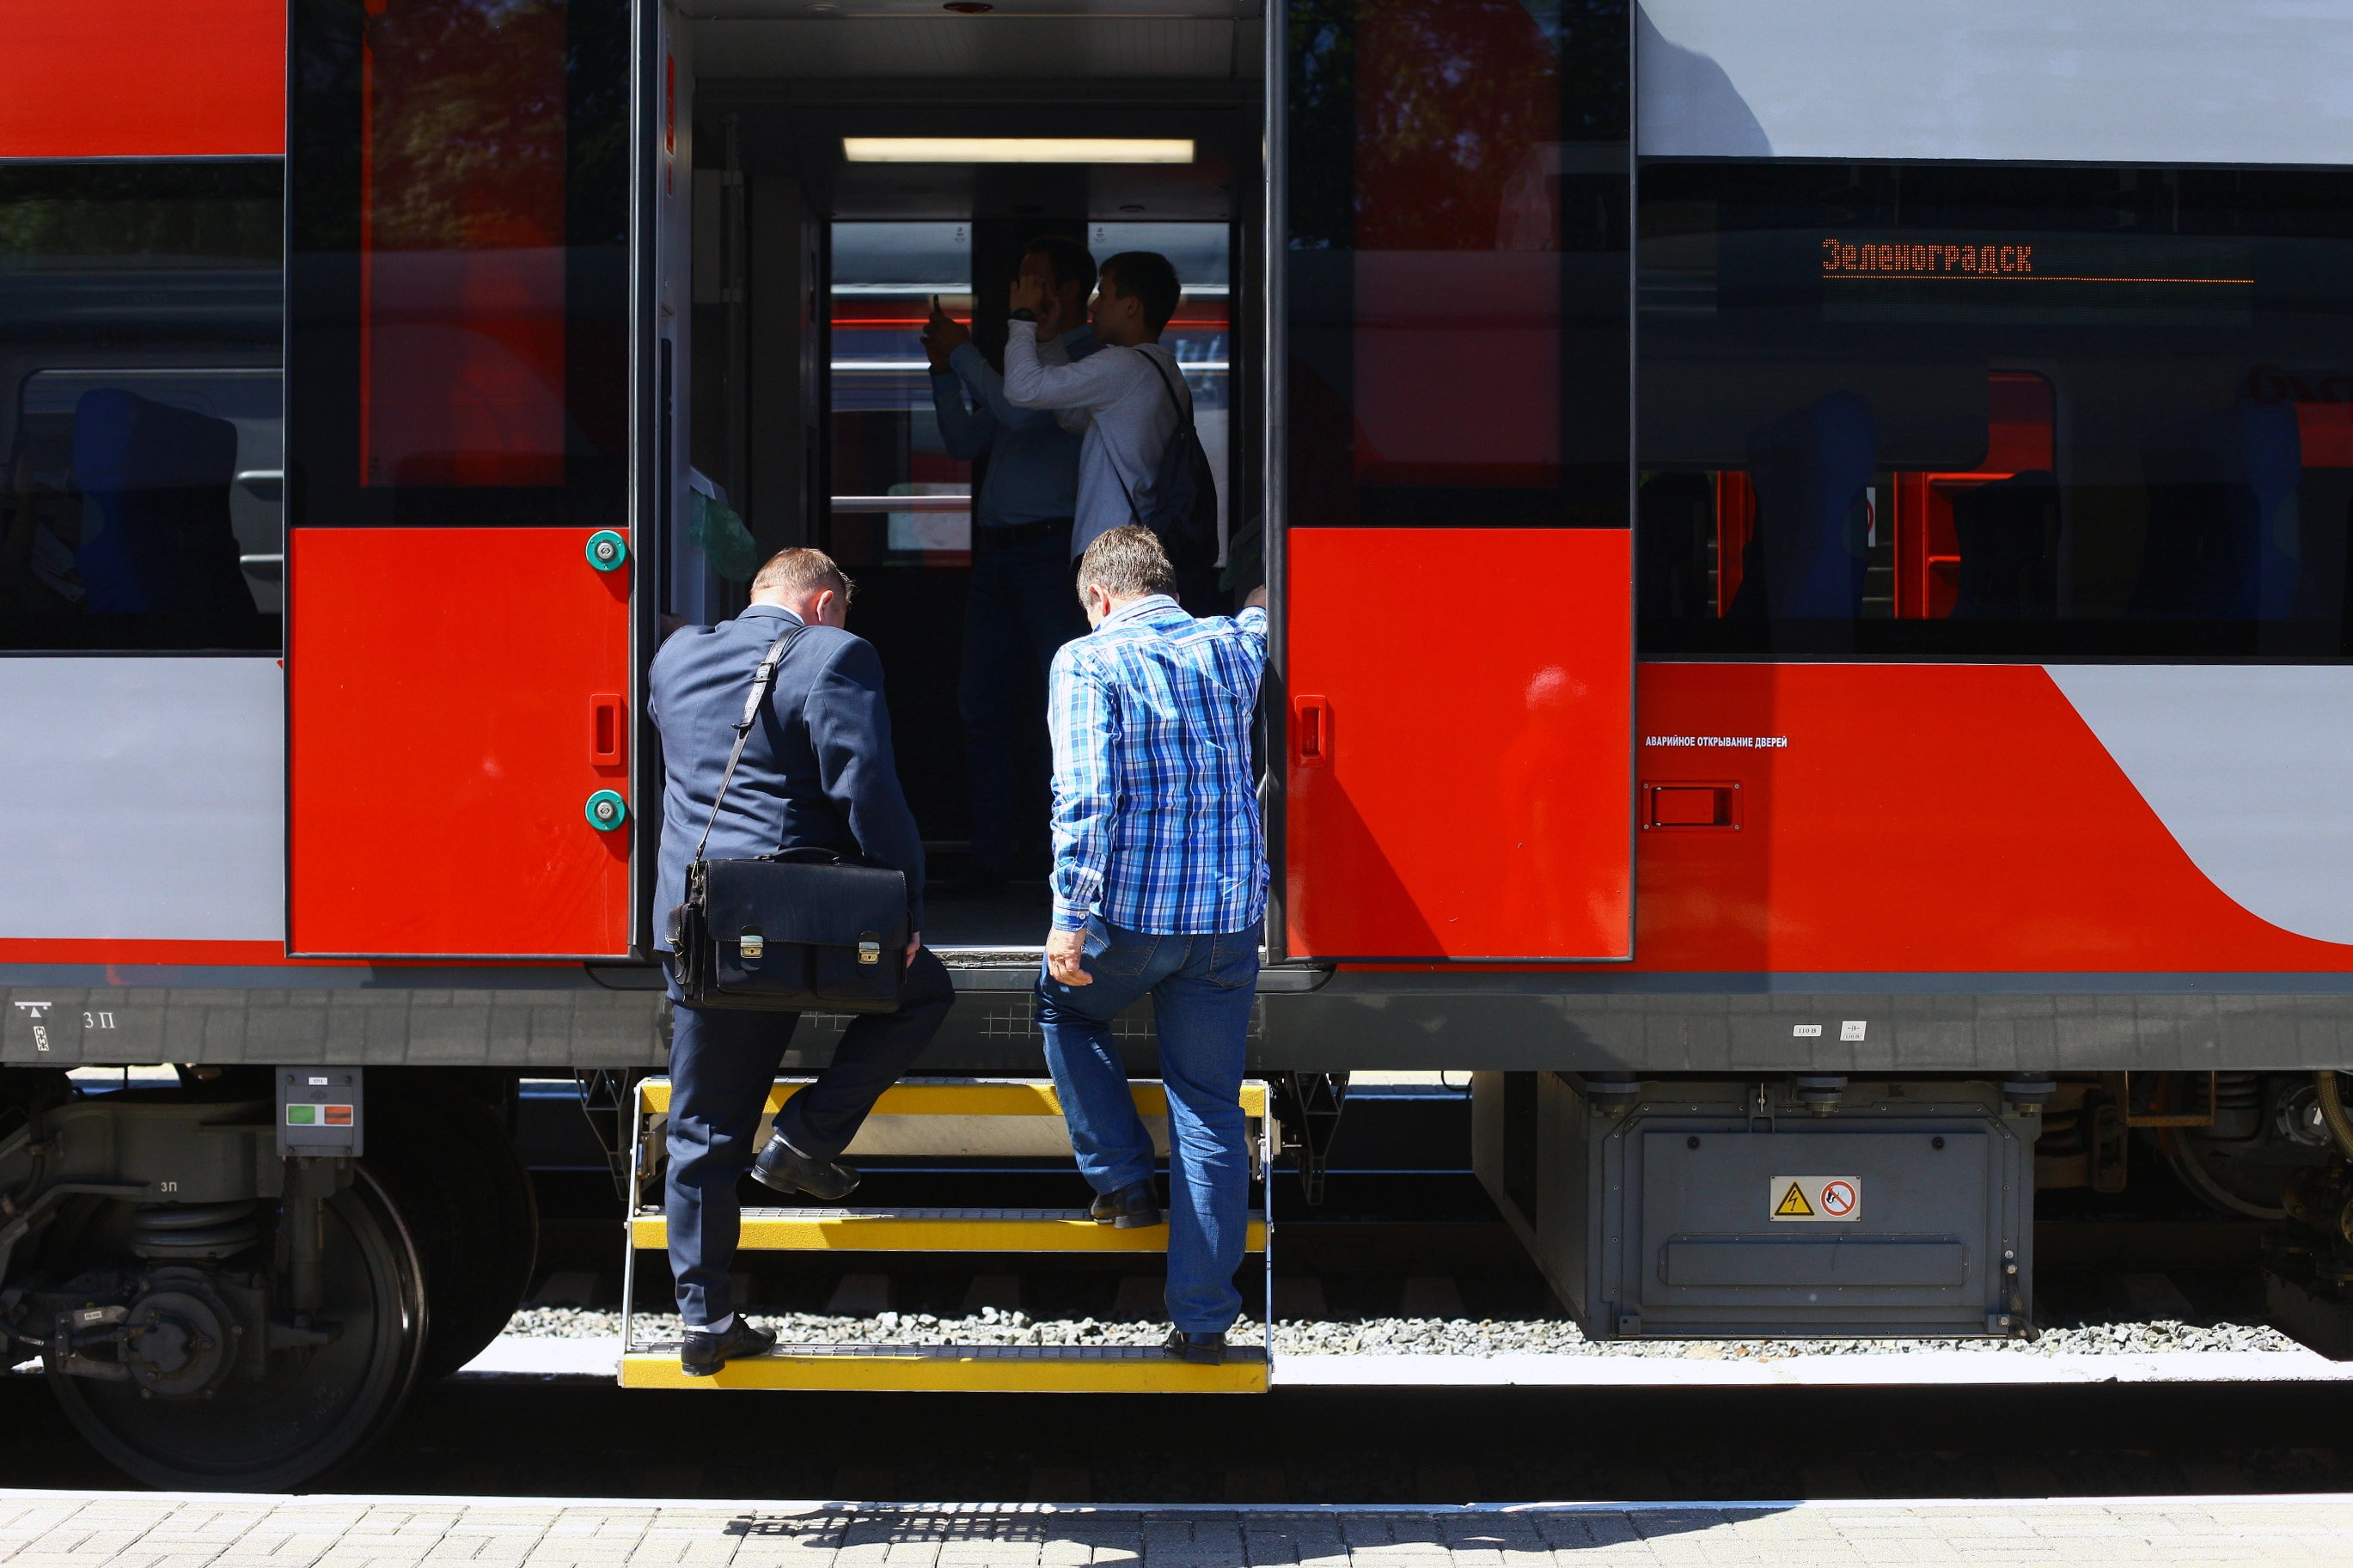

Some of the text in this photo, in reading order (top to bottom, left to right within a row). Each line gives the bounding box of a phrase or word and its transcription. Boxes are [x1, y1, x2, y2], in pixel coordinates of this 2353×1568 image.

[1822, 238, 2033, 274] Зеленоградск
[1646, 735, 1788, 749] АВАРИЙНОЕ ОТКРЫВАНИЕ ДВЕРЕЙ
